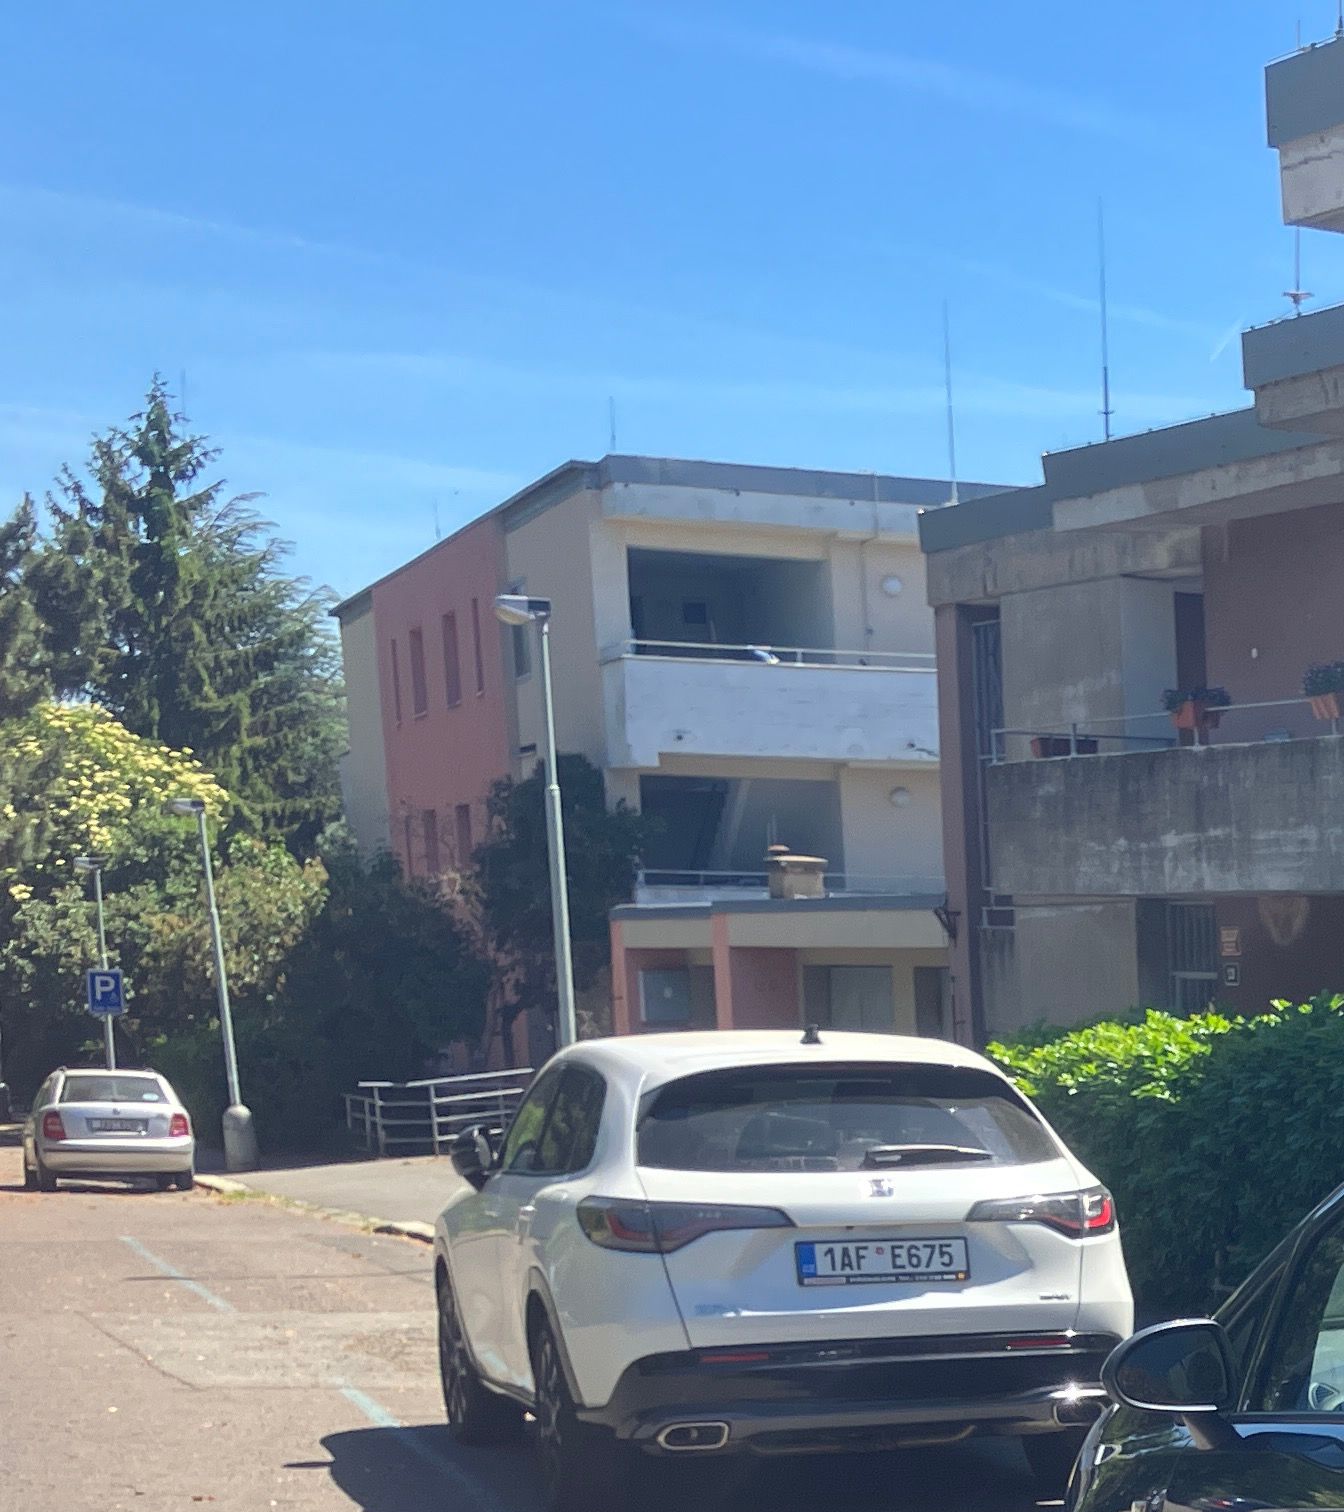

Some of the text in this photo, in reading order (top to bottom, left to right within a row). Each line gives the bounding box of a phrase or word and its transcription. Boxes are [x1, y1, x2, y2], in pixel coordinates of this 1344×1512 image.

[95, 975, 116, 1000] P
[823, 1243, 954, 1272] 1AF E675
